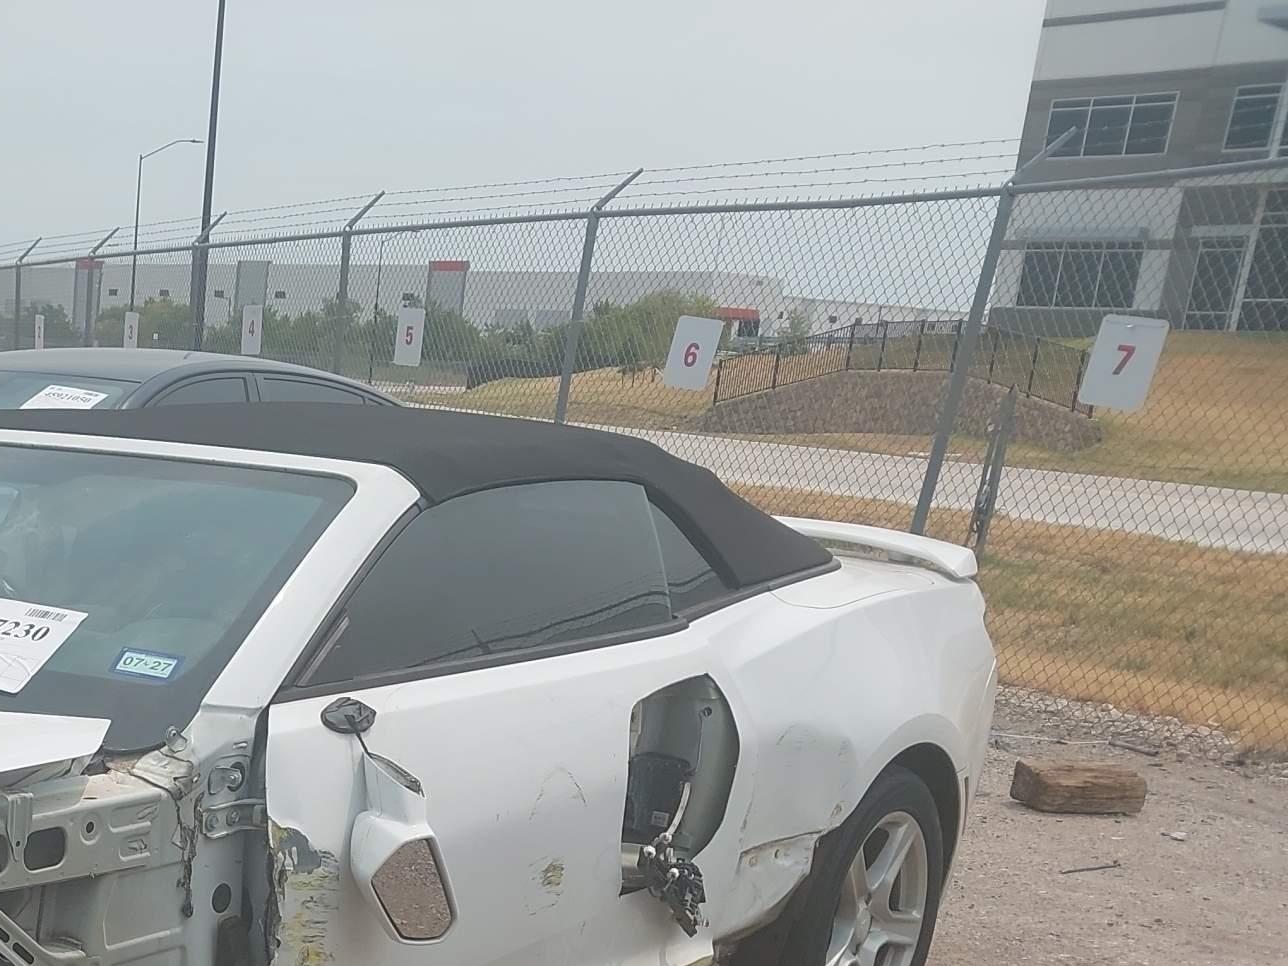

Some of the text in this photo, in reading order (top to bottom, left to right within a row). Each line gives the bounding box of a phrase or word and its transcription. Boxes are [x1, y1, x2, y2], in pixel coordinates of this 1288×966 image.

[248, 319, 255, 337] 4
[405, 325, 414, 345] 5
[684, 342, 700, 368] 6
[1112, 344, 1137, 376] 7
